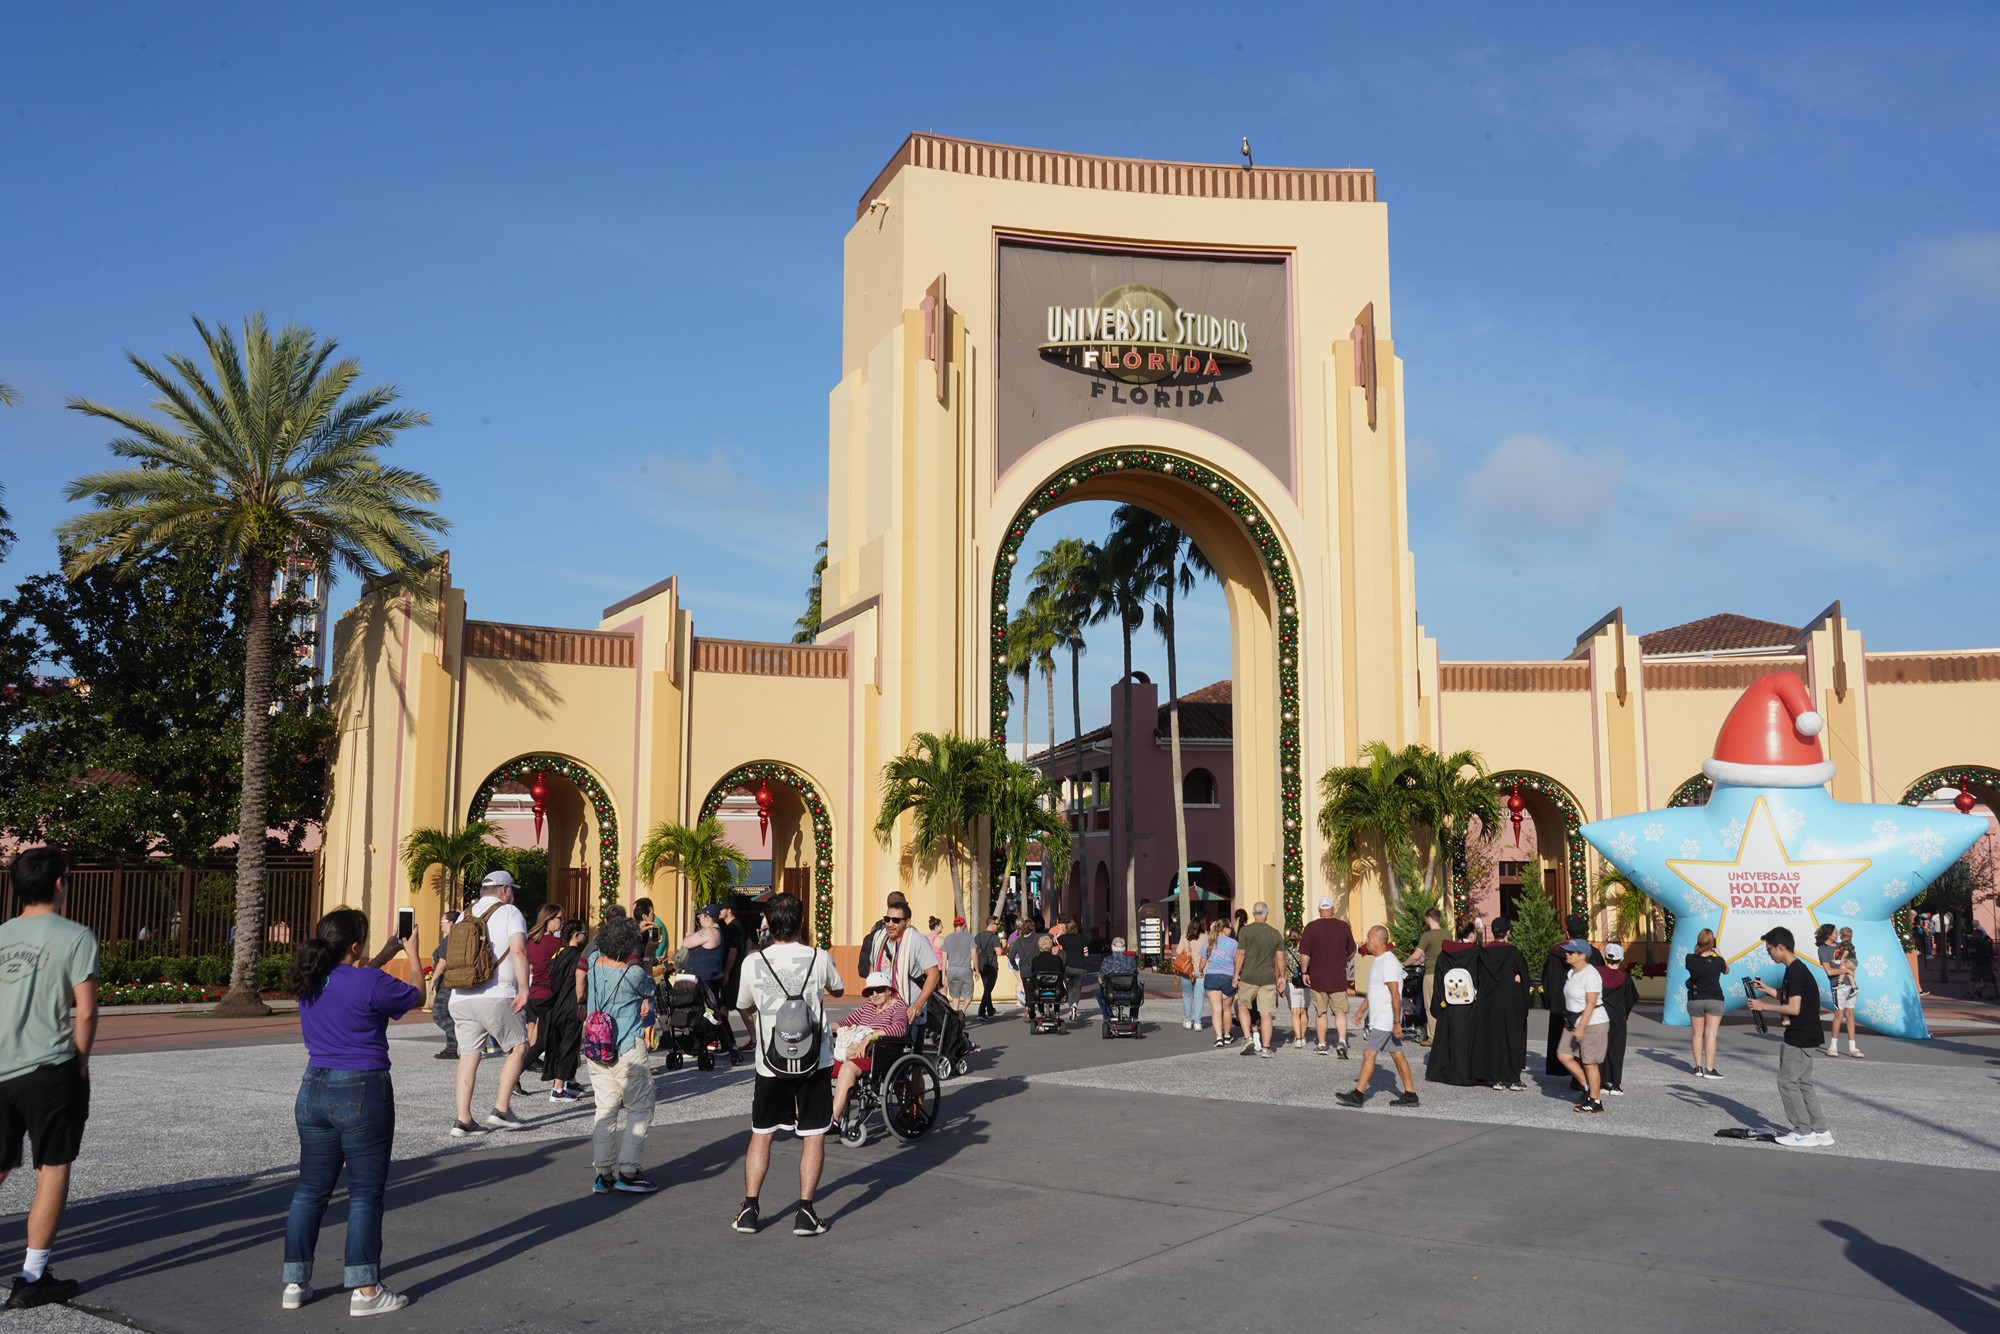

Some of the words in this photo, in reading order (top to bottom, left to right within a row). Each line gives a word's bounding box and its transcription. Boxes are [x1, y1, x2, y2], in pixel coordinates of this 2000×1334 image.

[1047, 305, 1168, 343] UNIVERSAL
[1175, 308, 1248, 353] STUDIOS
[1083, 351, 1221, 376] FLORIDA
[1728, 872, 1801, 881] UNIVERSAL'S
[1729, 883, 1800, 895] HOLIDAY
[1731, 896, 1802, 909] PARADE
